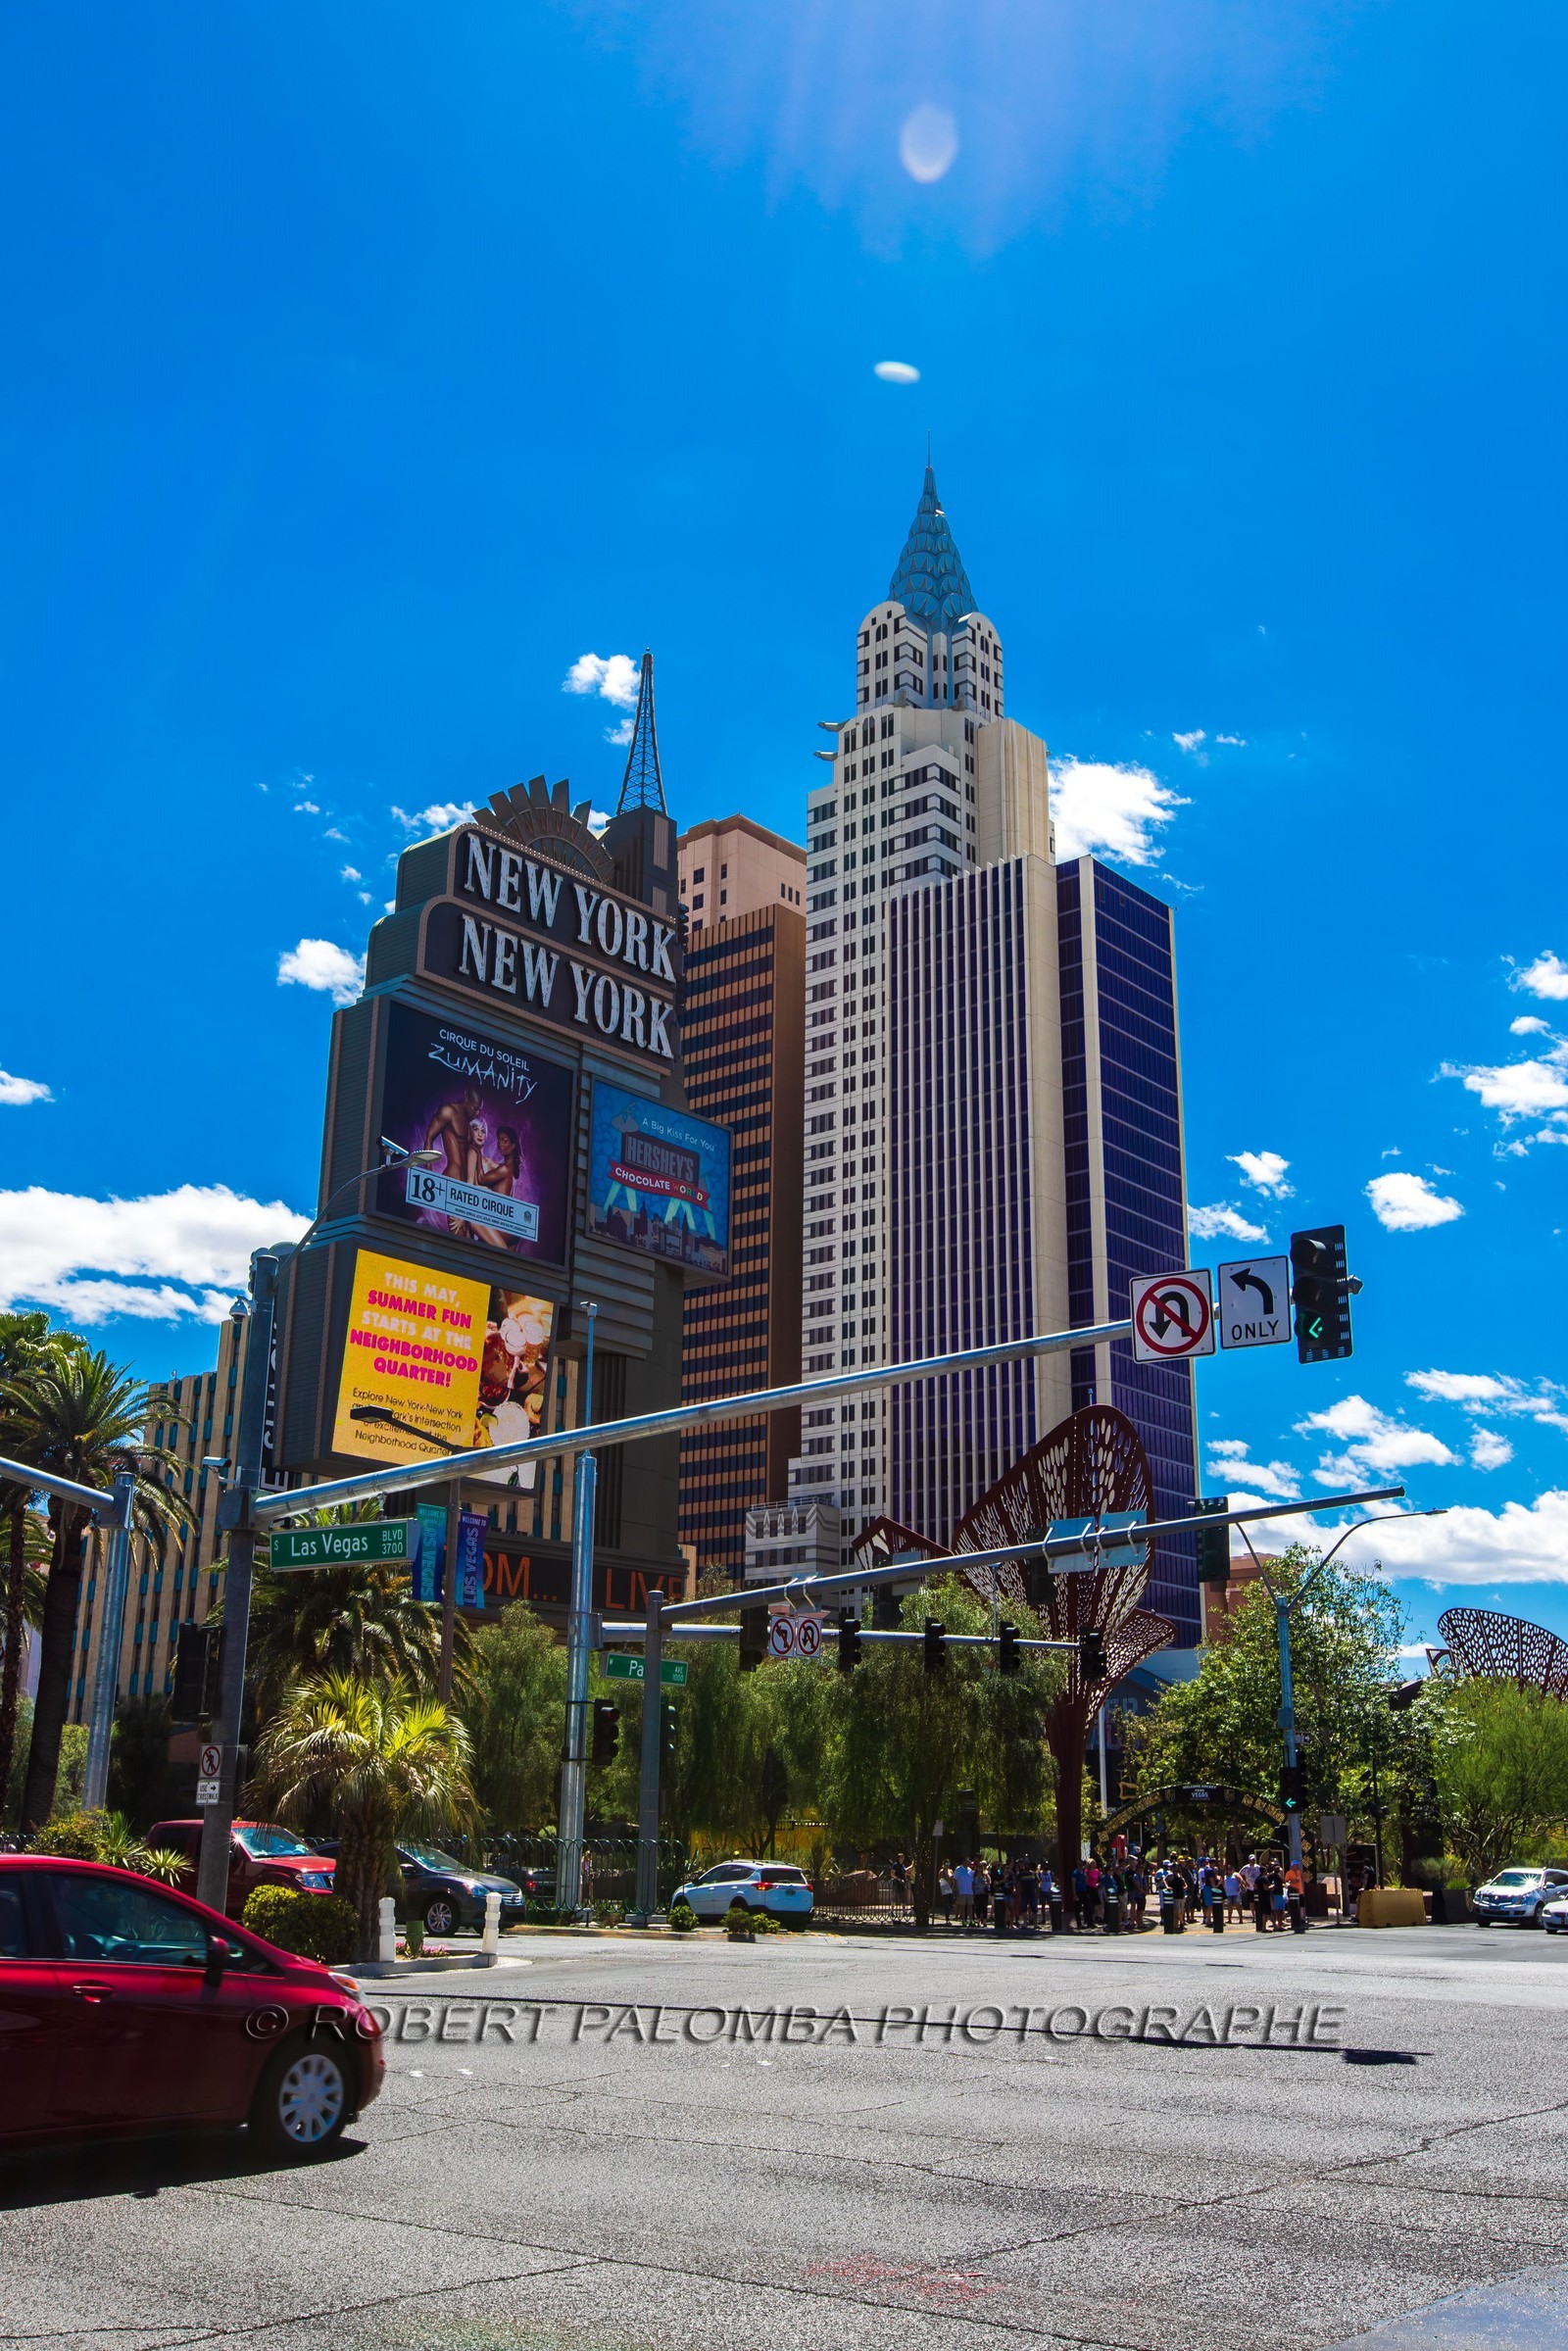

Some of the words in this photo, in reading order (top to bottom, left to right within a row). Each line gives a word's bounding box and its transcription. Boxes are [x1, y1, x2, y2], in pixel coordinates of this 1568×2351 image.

[464, 833, 563, 929] NEW
[573, 882, 676, 983] YORK
[459, 913, 561, 1008] NEW
[569, 960, 674, 1059] YORK
[439, 1029, 477, 1052] CIRQUE
[479, 1044, 495, 1057] DU
[496, 1051, 530, 1072] SOLEIL
[642, 1117, 649, 1127] A
[651, 1120, 664, 1135] Big
[666, 1126, 683, 1141] Kiss
[685, 1133, 699, 1146] For
[701, 1139, 715, 1152] You
[626, 1136, 695, 1183] HERSHEY'S
[614, 1166, 671, 1191] CHOCOLATE
[672, 1182, 704, 1201] WORLD
[450, 1187, 480, 1208] RATED
[481, 1197, 514, 1219] CIRQUE
[384, 1272, 418, 1295] THIS
[422, 1282, 461, 1308] MAY,
[368, 1289, 437, 1320] SUMMER
[442, 1308, 472, 1330] FUN
[362, 1310, 417, 1337] STARTS
[421, 1327, 441, 1343] AT
[445, 1330, 472, 1350] THE
[1231, 1319, 1280, 1342] ONLY
[349, 1327, 478, 1372] NEIGHBORHOOD
[373, 1356, 452, 1388] QUARTER!
[353, 1387, 384, 1403] Explore
[386, 1395, 406, 1407] New
[407, 1398, 445, 1416] York-New
[446, 1408, 464, 1420] York
[391, 1409, 414, 1423] ark's
[415, 1413, 462, 1433] Intersection
[354, 1429, 417, 1450] Neighborhood
[423, 1518, 438, 1547] LAS
[462, 1515, 480, 1526] WELCOME
[273, 1540, 279, 1551] S
[291, 1536, 318, 1557] Las
[321, 1533, 368, 1558] Vegas
[381, 1529, 403, 1543] BLVD
[381, 1542, 404, 1555] 3700
[465, 1527, 479, 1573] VEGAS
[420, 1549, 437, 1597] VEGAS
[464, 1575, 477, 1604] LAS
